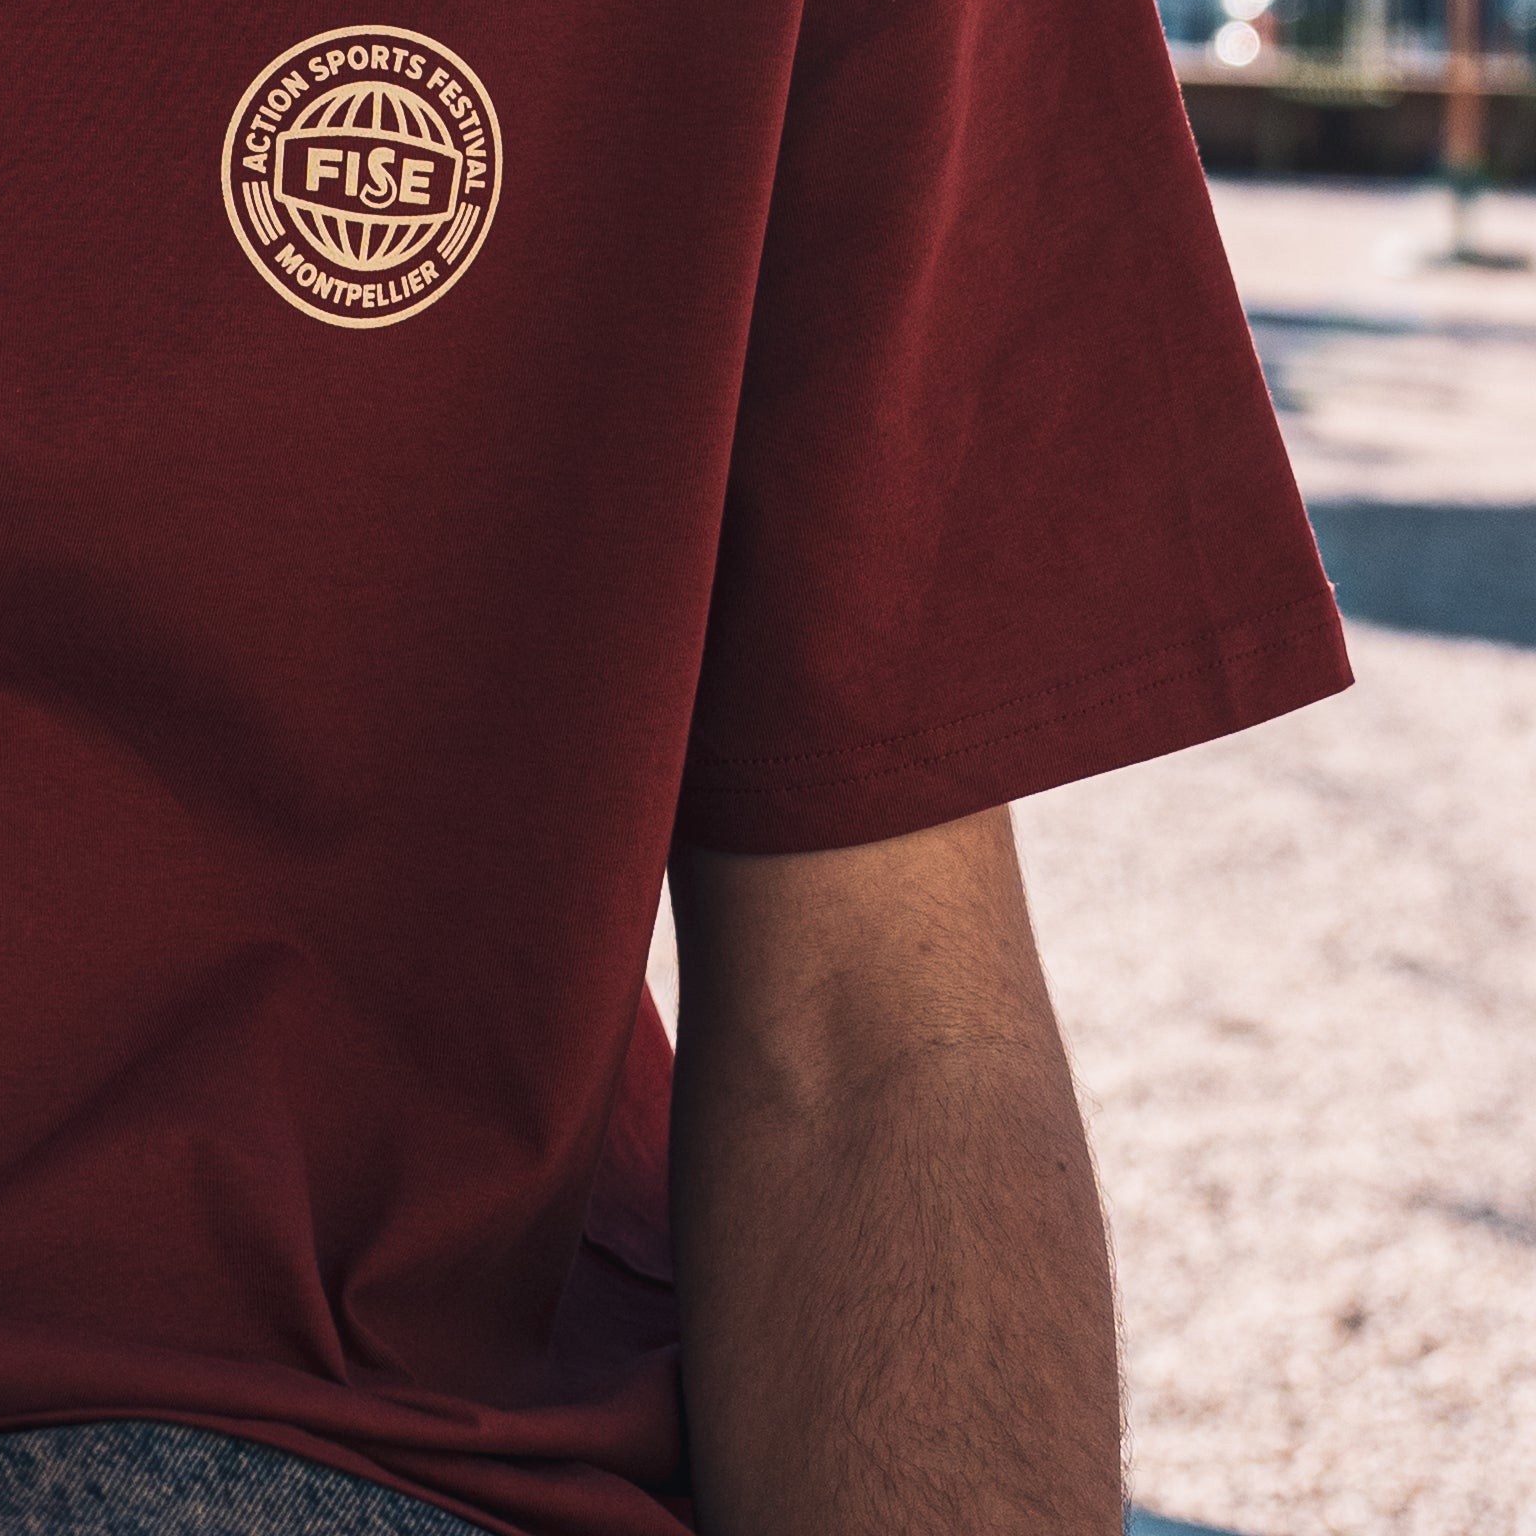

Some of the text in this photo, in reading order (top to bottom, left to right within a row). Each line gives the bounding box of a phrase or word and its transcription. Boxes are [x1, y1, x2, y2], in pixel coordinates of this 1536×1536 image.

[242, 45, 487, 194] ACTION SPORTS FESTIVAL
[306, 146, 435, 209] FISE
[274, 243, 440, 308] MONTPELLIER
